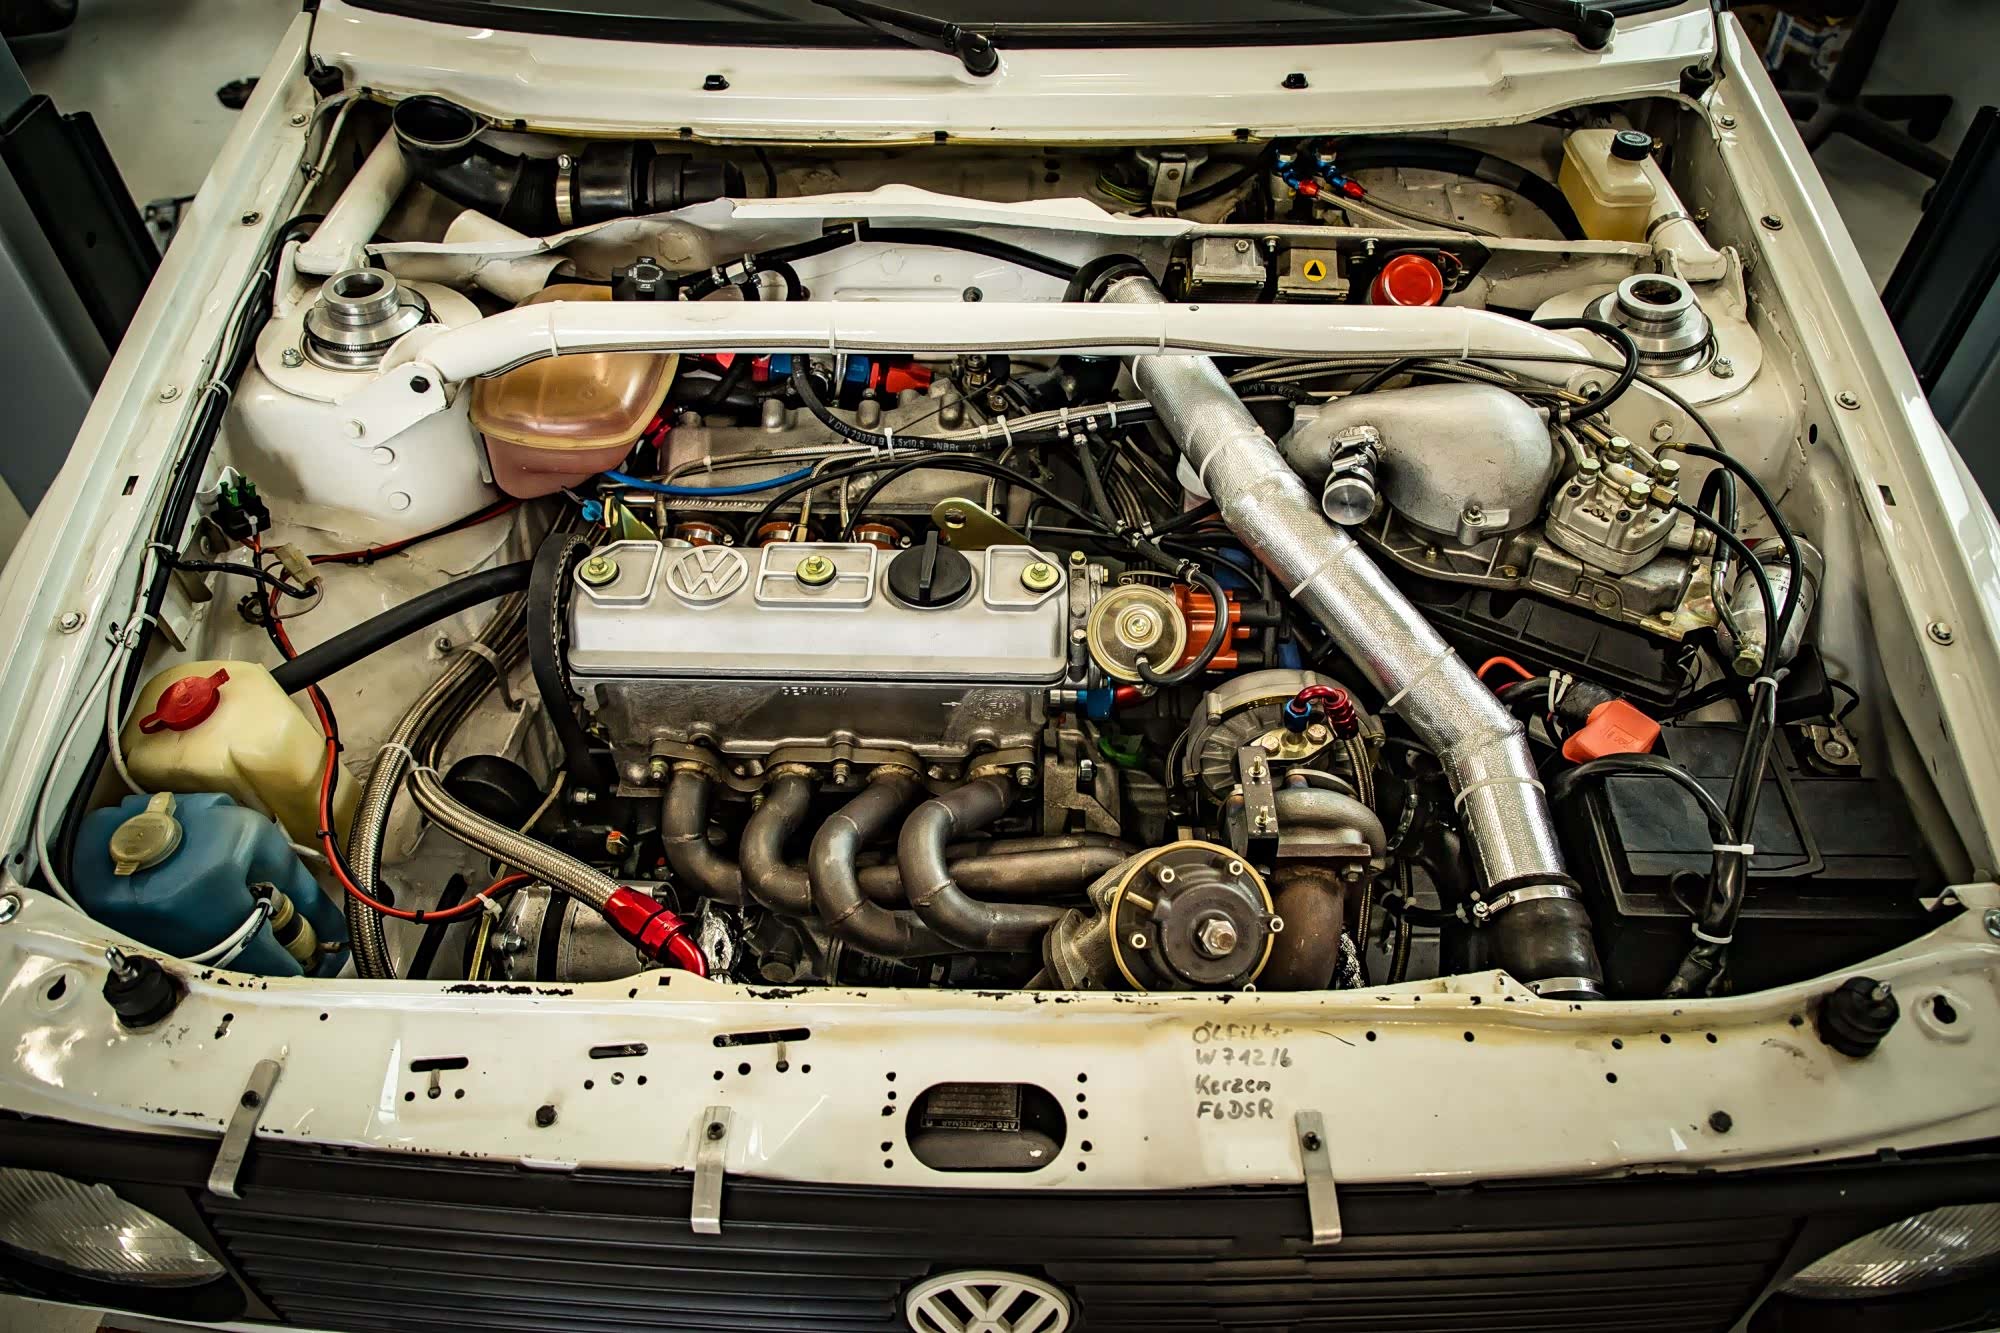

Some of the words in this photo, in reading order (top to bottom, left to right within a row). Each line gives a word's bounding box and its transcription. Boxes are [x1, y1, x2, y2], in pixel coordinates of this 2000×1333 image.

[834, 420, 850, 435] DIN
[667, 545, 748, 600] VW
[781, 686, 848, 696] GERMANY
[1195, 1074, 1271, 1096] Kerzen
[1197, 1098, 1274, 1119] F6DSR
[906, 1271, 1070, 1333] VW
